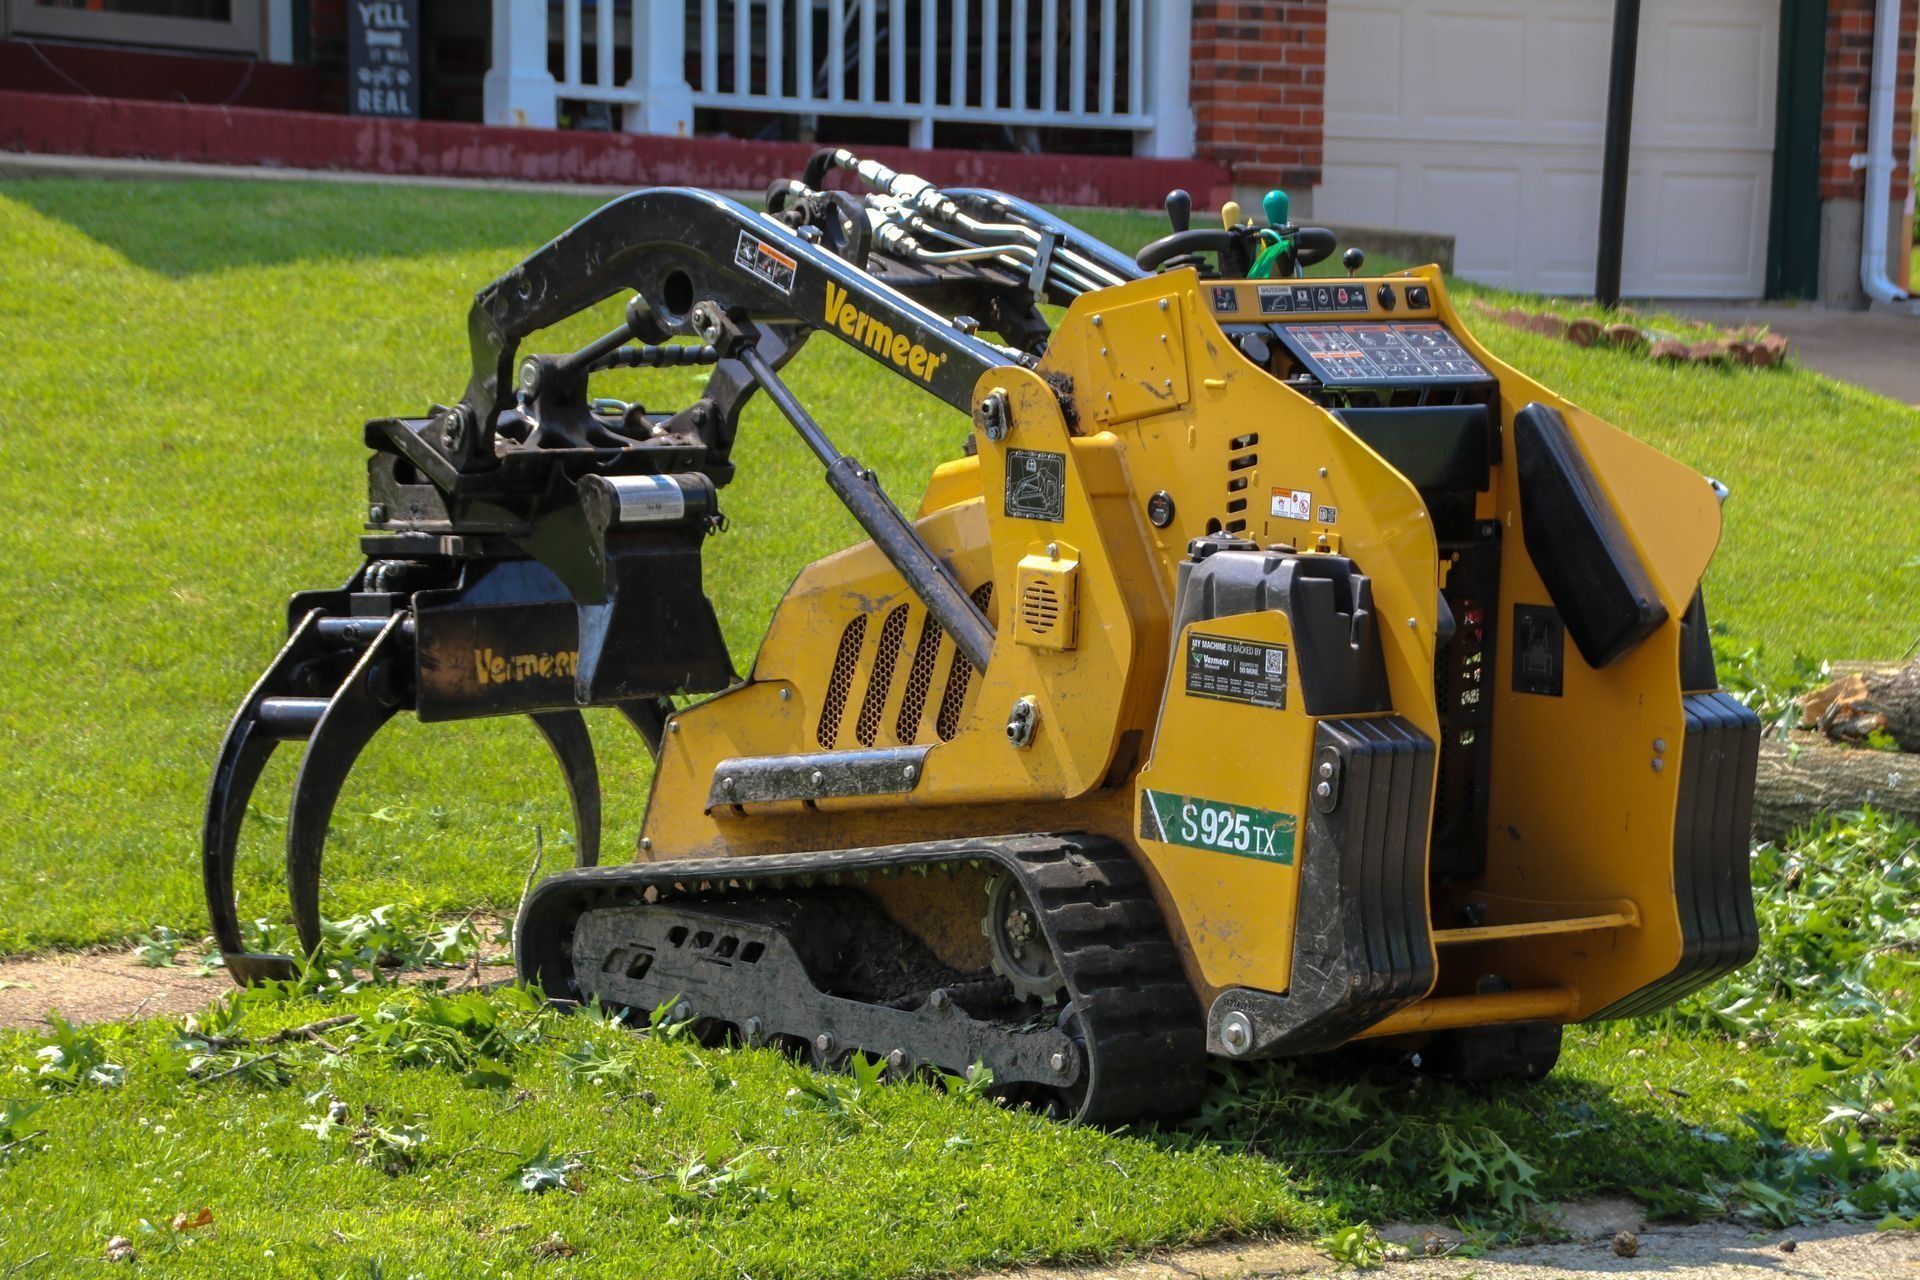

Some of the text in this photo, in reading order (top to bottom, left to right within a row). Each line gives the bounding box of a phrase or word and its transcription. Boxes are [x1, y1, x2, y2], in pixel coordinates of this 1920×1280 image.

[357, 2, 410, 28] YELL
[358, 87, 411, 114] REAL
[824, 280, 941, 383] Vermeer
[1192, 639, 1201, 648] MY
[1202, 640, 1226, 651] MACHINE
[1233, 645, 1254, 655] BACKED
[1254, 647, 1262, 656] BY
[1203, 654, 1230, 666] Vermeer
